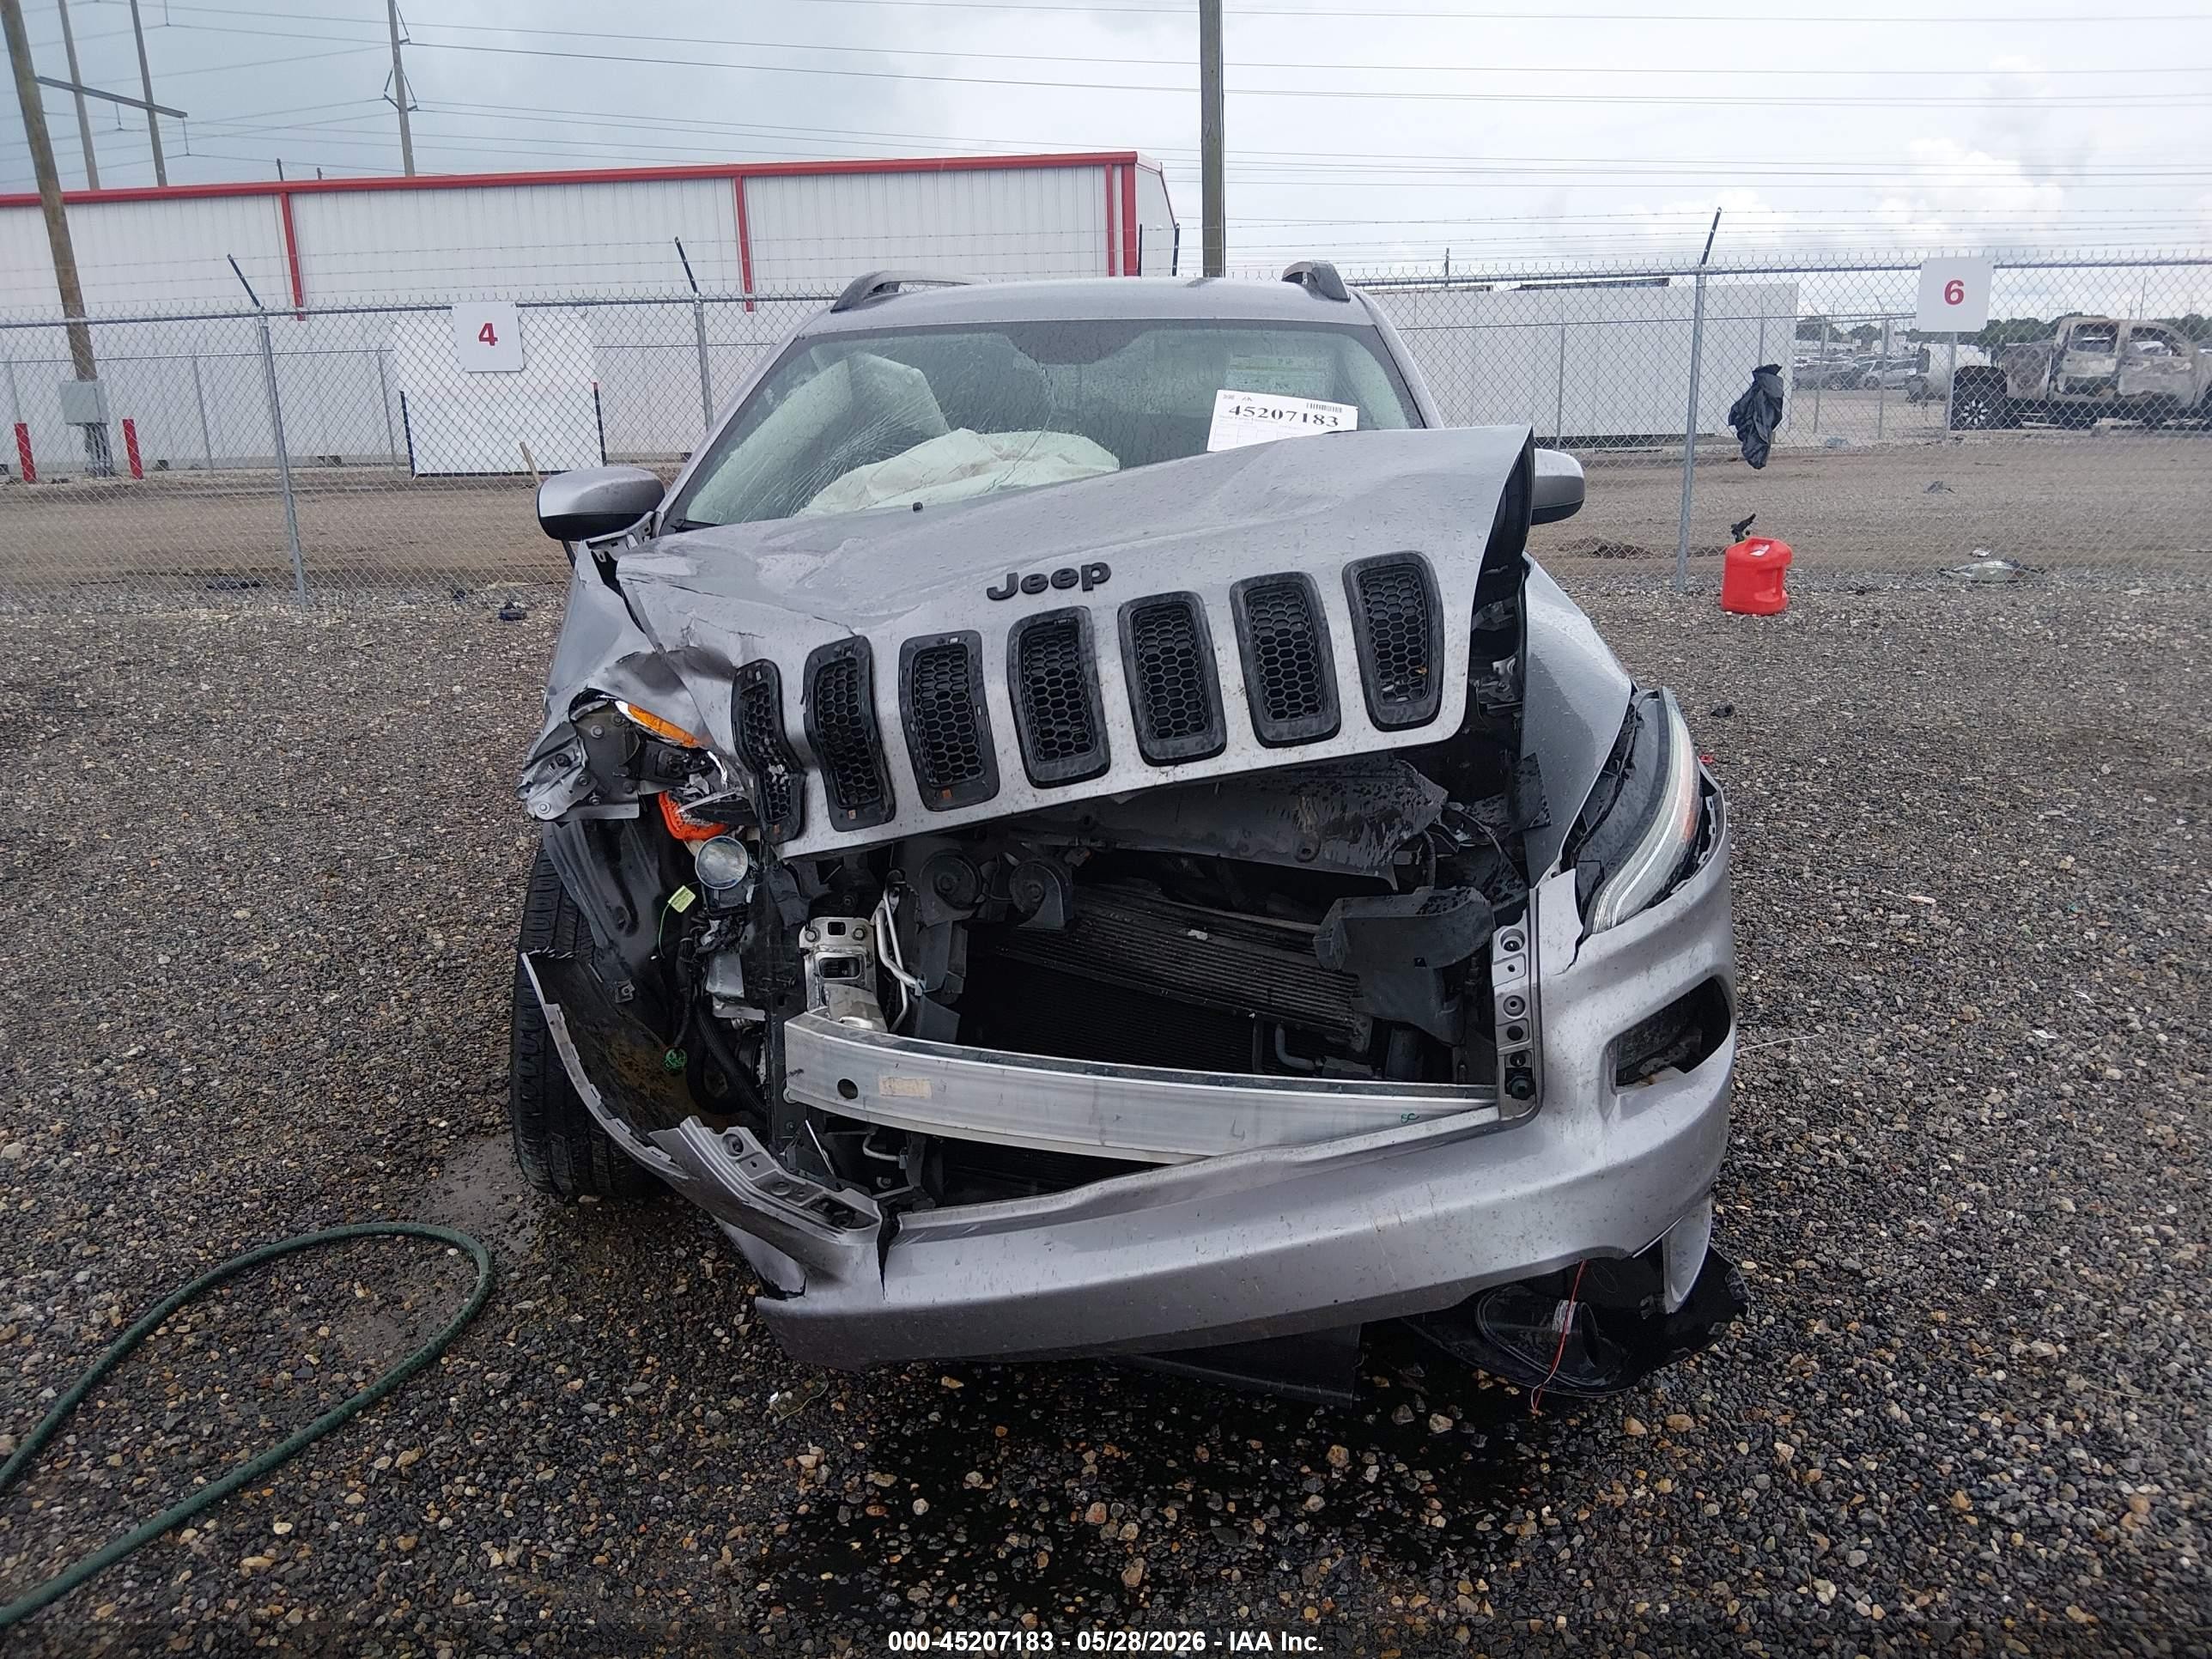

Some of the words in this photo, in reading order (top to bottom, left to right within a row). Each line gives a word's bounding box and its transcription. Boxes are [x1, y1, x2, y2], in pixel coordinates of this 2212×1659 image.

[1944, 280, 1964, 305] 6
[478, 323, 498, 346] 4
[1229, 405, 1338, 427] 45207183
[987, 562, 1111, 600] Jeep
